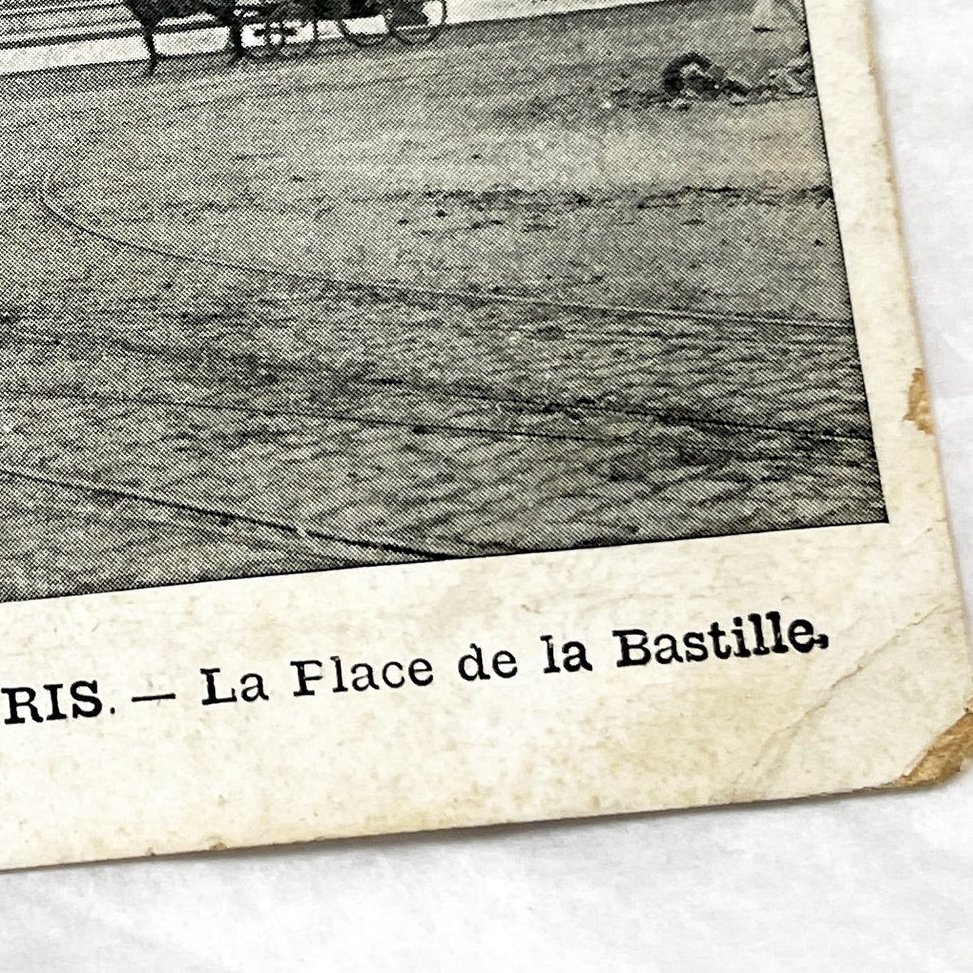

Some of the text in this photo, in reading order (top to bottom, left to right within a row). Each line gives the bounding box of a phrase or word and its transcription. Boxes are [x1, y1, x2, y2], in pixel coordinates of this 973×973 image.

[199, 667, 271, 706] La
[458, 643, 519, 682] de
[540, 634, 594, 674] la
